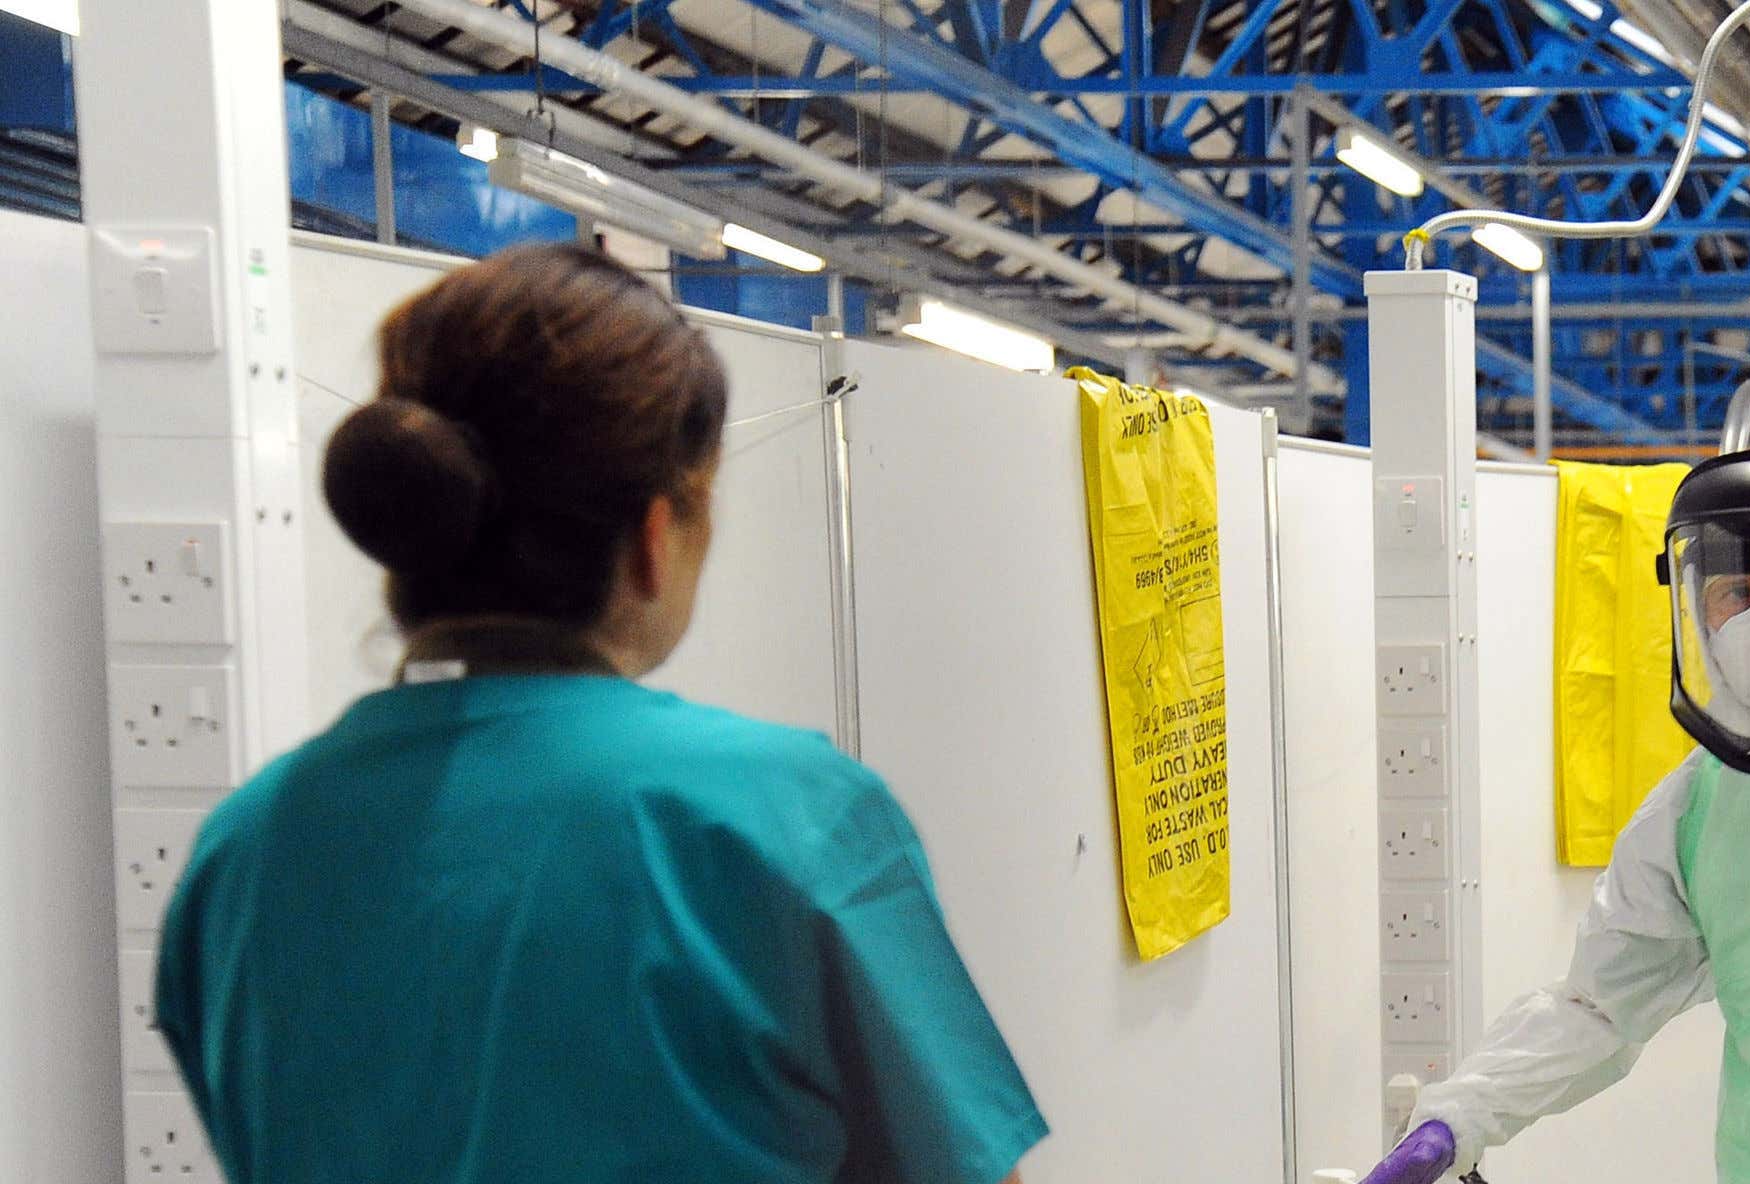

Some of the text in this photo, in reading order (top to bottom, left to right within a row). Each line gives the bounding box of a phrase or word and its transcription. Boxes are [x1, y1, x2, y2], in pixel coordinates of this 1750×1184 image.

[1150, 754, 1187, 786] DUTY
[1144, 789, 1168, 817] ONLY
[1146, 818, 1164, 845] FOR
[1164, 804, 1208, 836] WASTE
[1147, 848, 1173, 879] ONLY
[1175, 838, 1200, 866] USE
